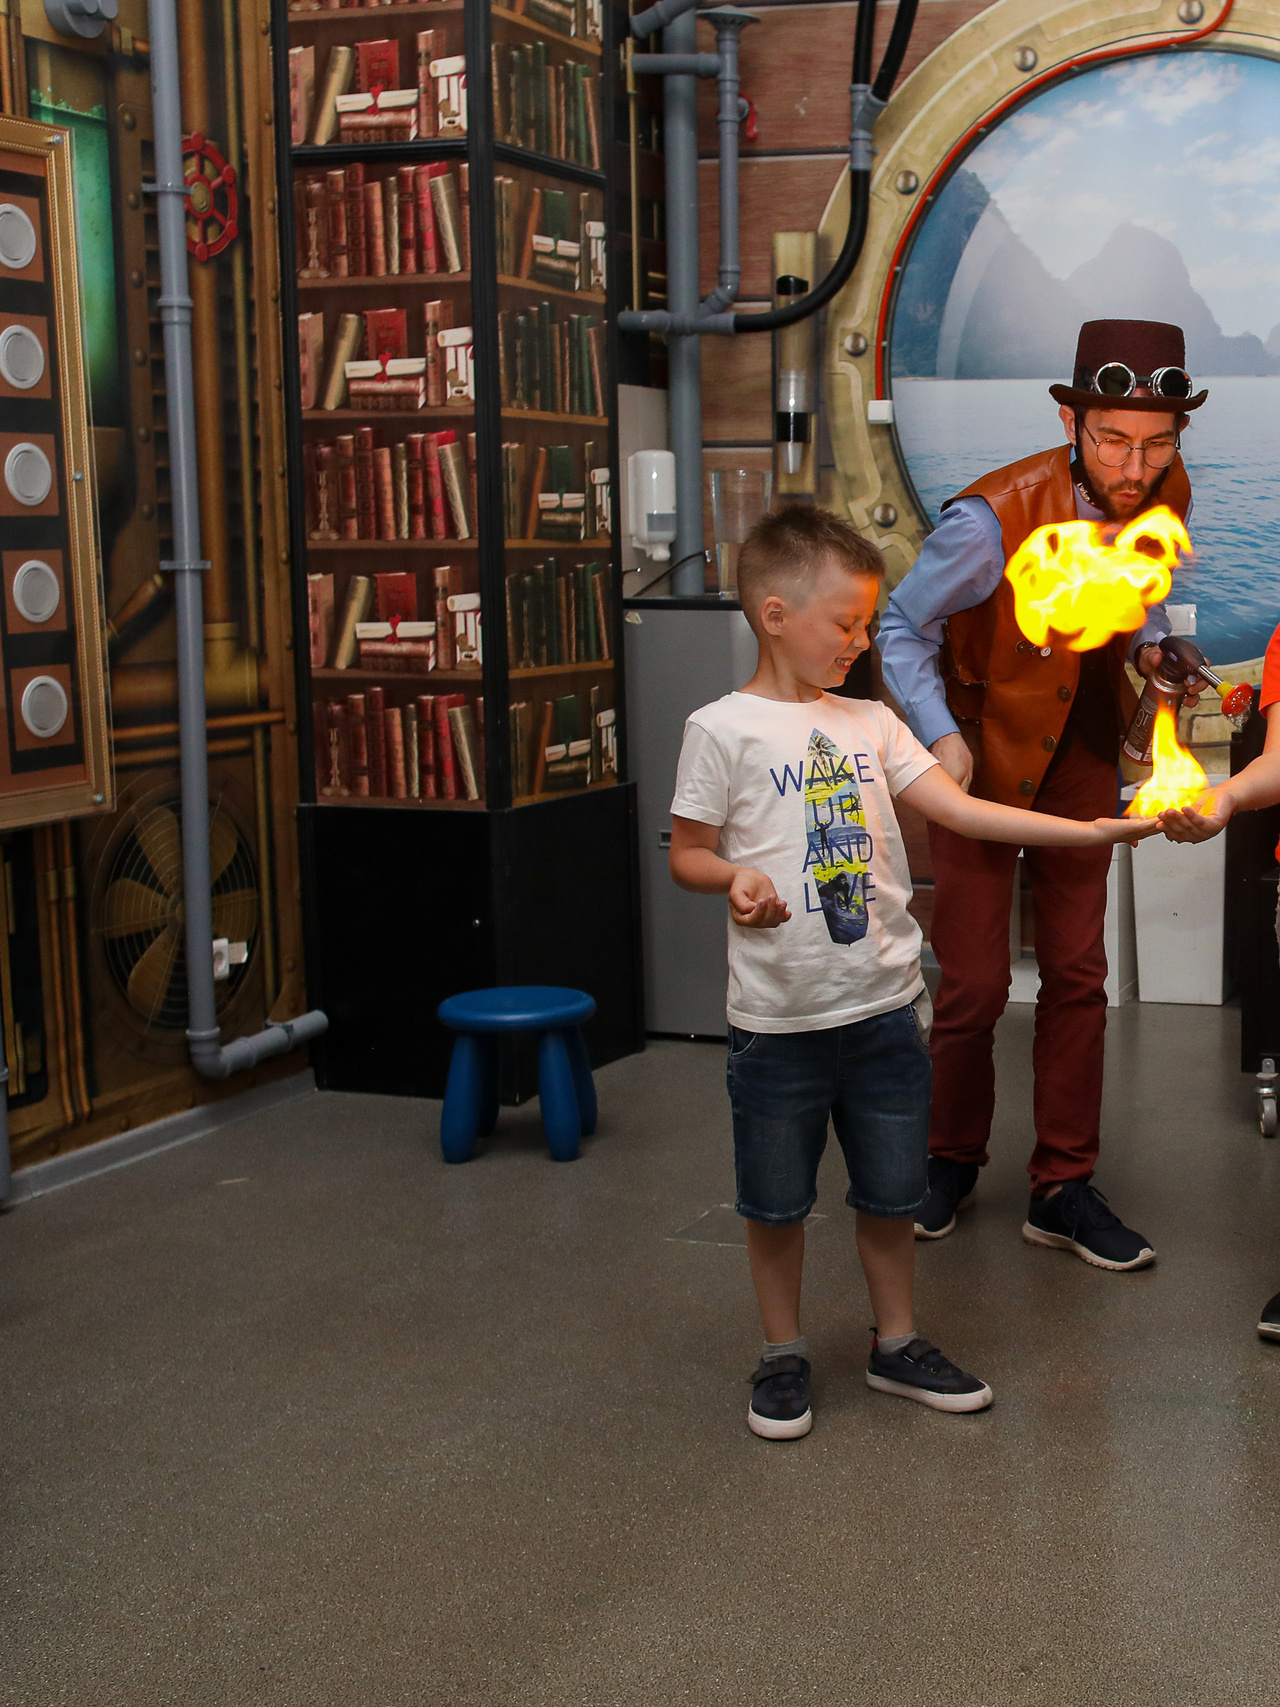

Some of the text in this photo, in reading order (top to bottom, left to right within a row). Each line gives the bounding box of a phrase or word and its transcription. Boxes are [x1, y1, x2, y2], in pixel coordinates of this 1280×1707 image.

[769, 753, 875, 797] WAKE
[812, 794, 859, 829] UP
[802, 833, 874, 873] AND
[804, 872, 876, 913] LVE
